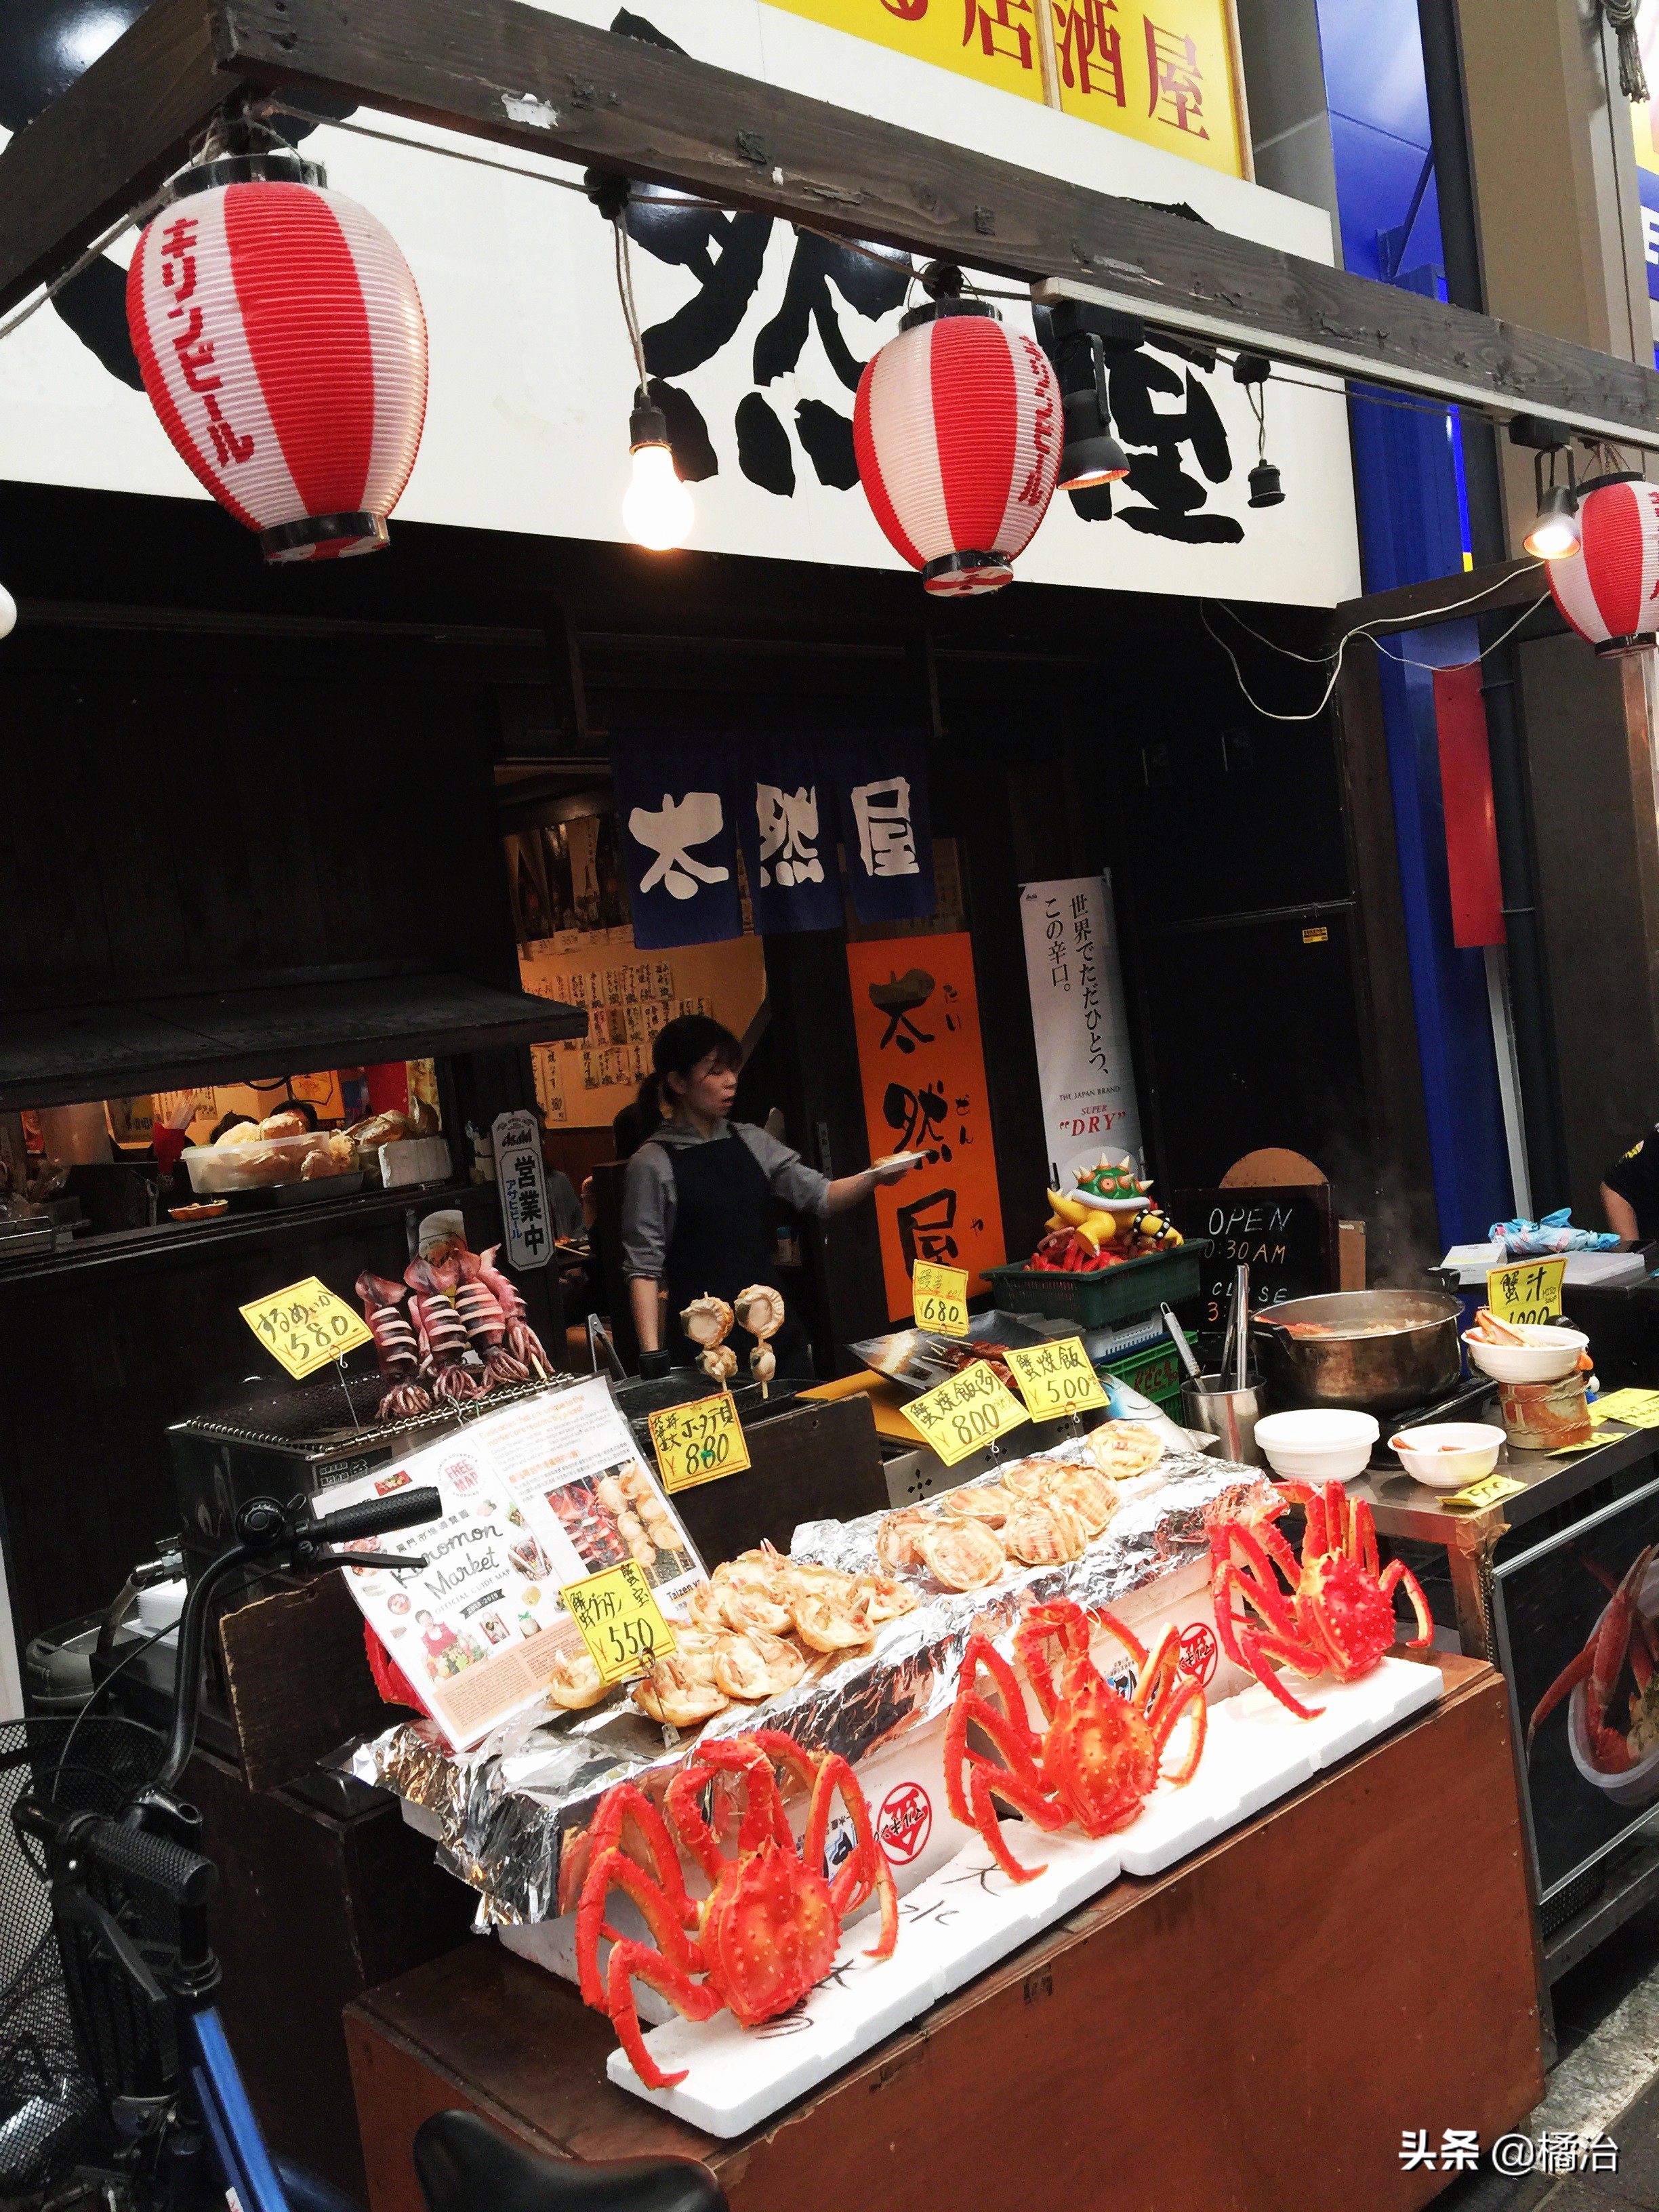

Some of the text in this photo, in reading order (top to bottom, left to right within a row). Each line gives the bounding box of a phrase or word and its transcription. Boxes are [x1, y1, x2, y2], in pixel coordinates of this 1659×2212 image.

[879, 0, 1210, 141] 居酒屋
[628, 776, 920, 901] 太然屋
[1044, 897, 1071, 992] この辛口。
[1069, 894, 1109, 1074] 世界でただひとつ、
[1074, 1090, 1095, 1100] JAPAN
[1097, 1086, 1120, 1096] BRAND
[1080, 1104, 1108, 1116] SUPER
[869, 968, 959, 1280] 太然屋
[506, 1179, 523, 1240] アサヒビール
[514, 1155, 545, 1256] 営業中
[1208, 1207, 1293, 1235] OPEN
[1212, 1282, 1288, 1303] CLSE
[444, 1458, 474, 1480] FREE
[453, 1471, 478, 1493] MAP
[424, 1546, 499, 1600] Market
[434, 1568, 512, 1614] OFFICIAL GUIDE MAP
[665, 1583, 693, 1601] Taizen
